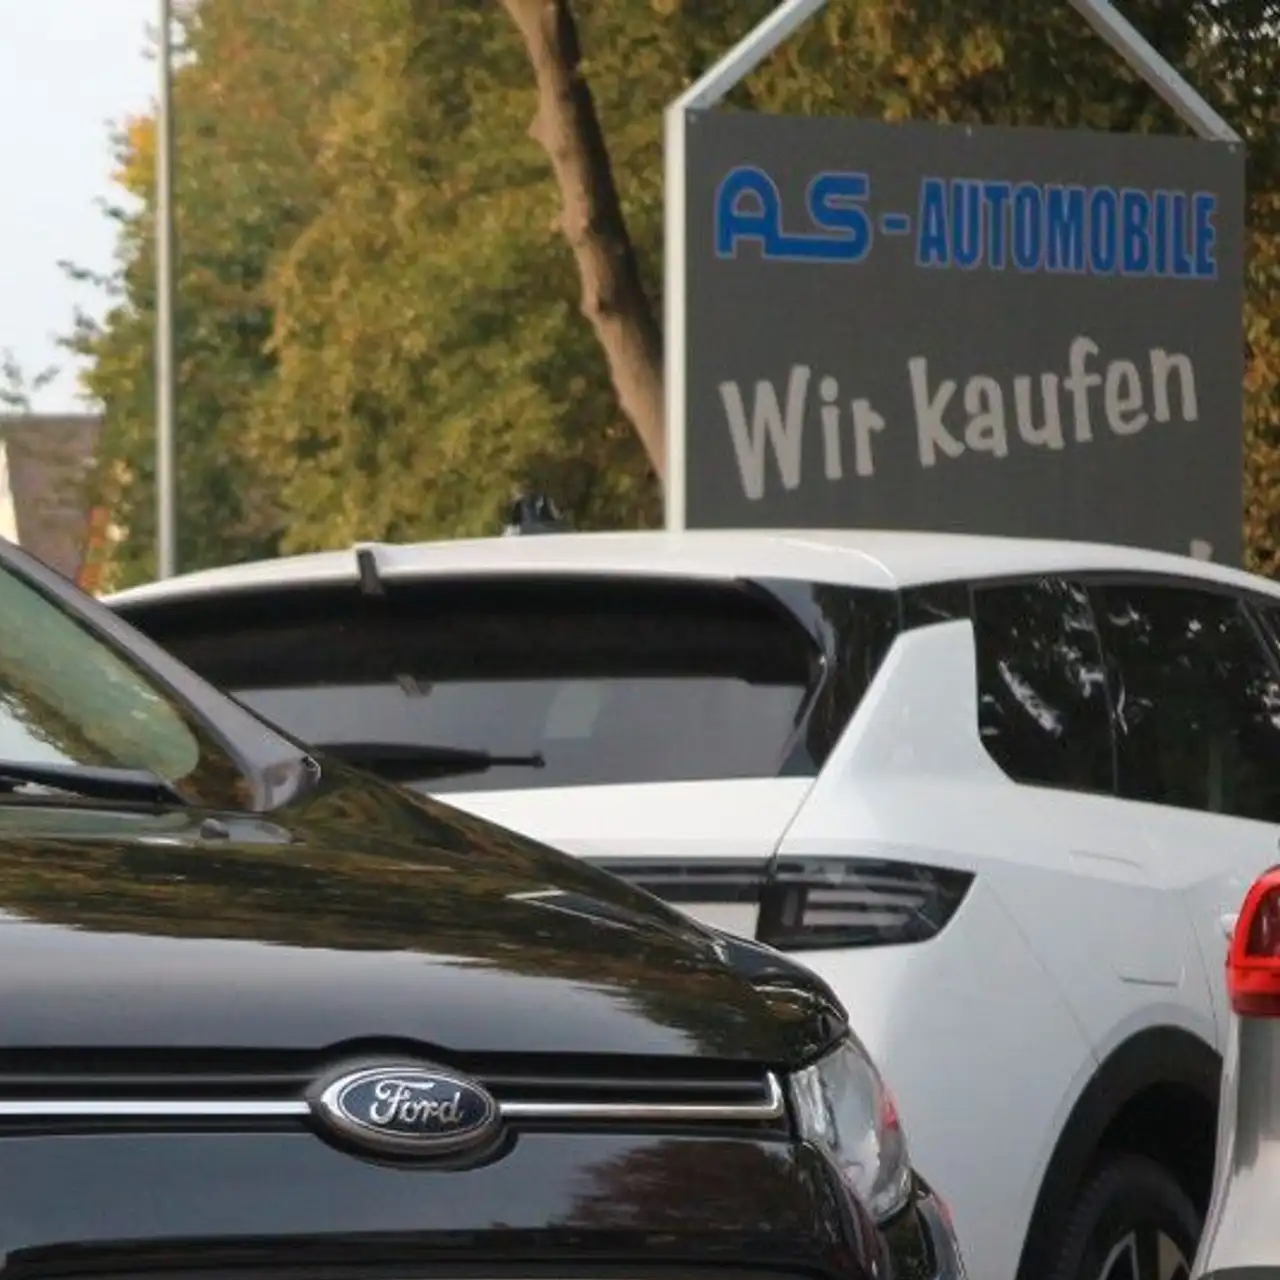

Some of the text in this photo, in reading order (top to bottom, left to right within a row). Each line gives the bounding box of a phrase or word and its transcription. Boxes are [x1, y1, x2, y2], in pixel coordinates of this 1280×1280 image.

[714, 165, 1219, 279] AS-AUTOMOBILE
[718, 335, 1199, 501] Wir kaufen
[369, 1079, 465, 1125] Ford
